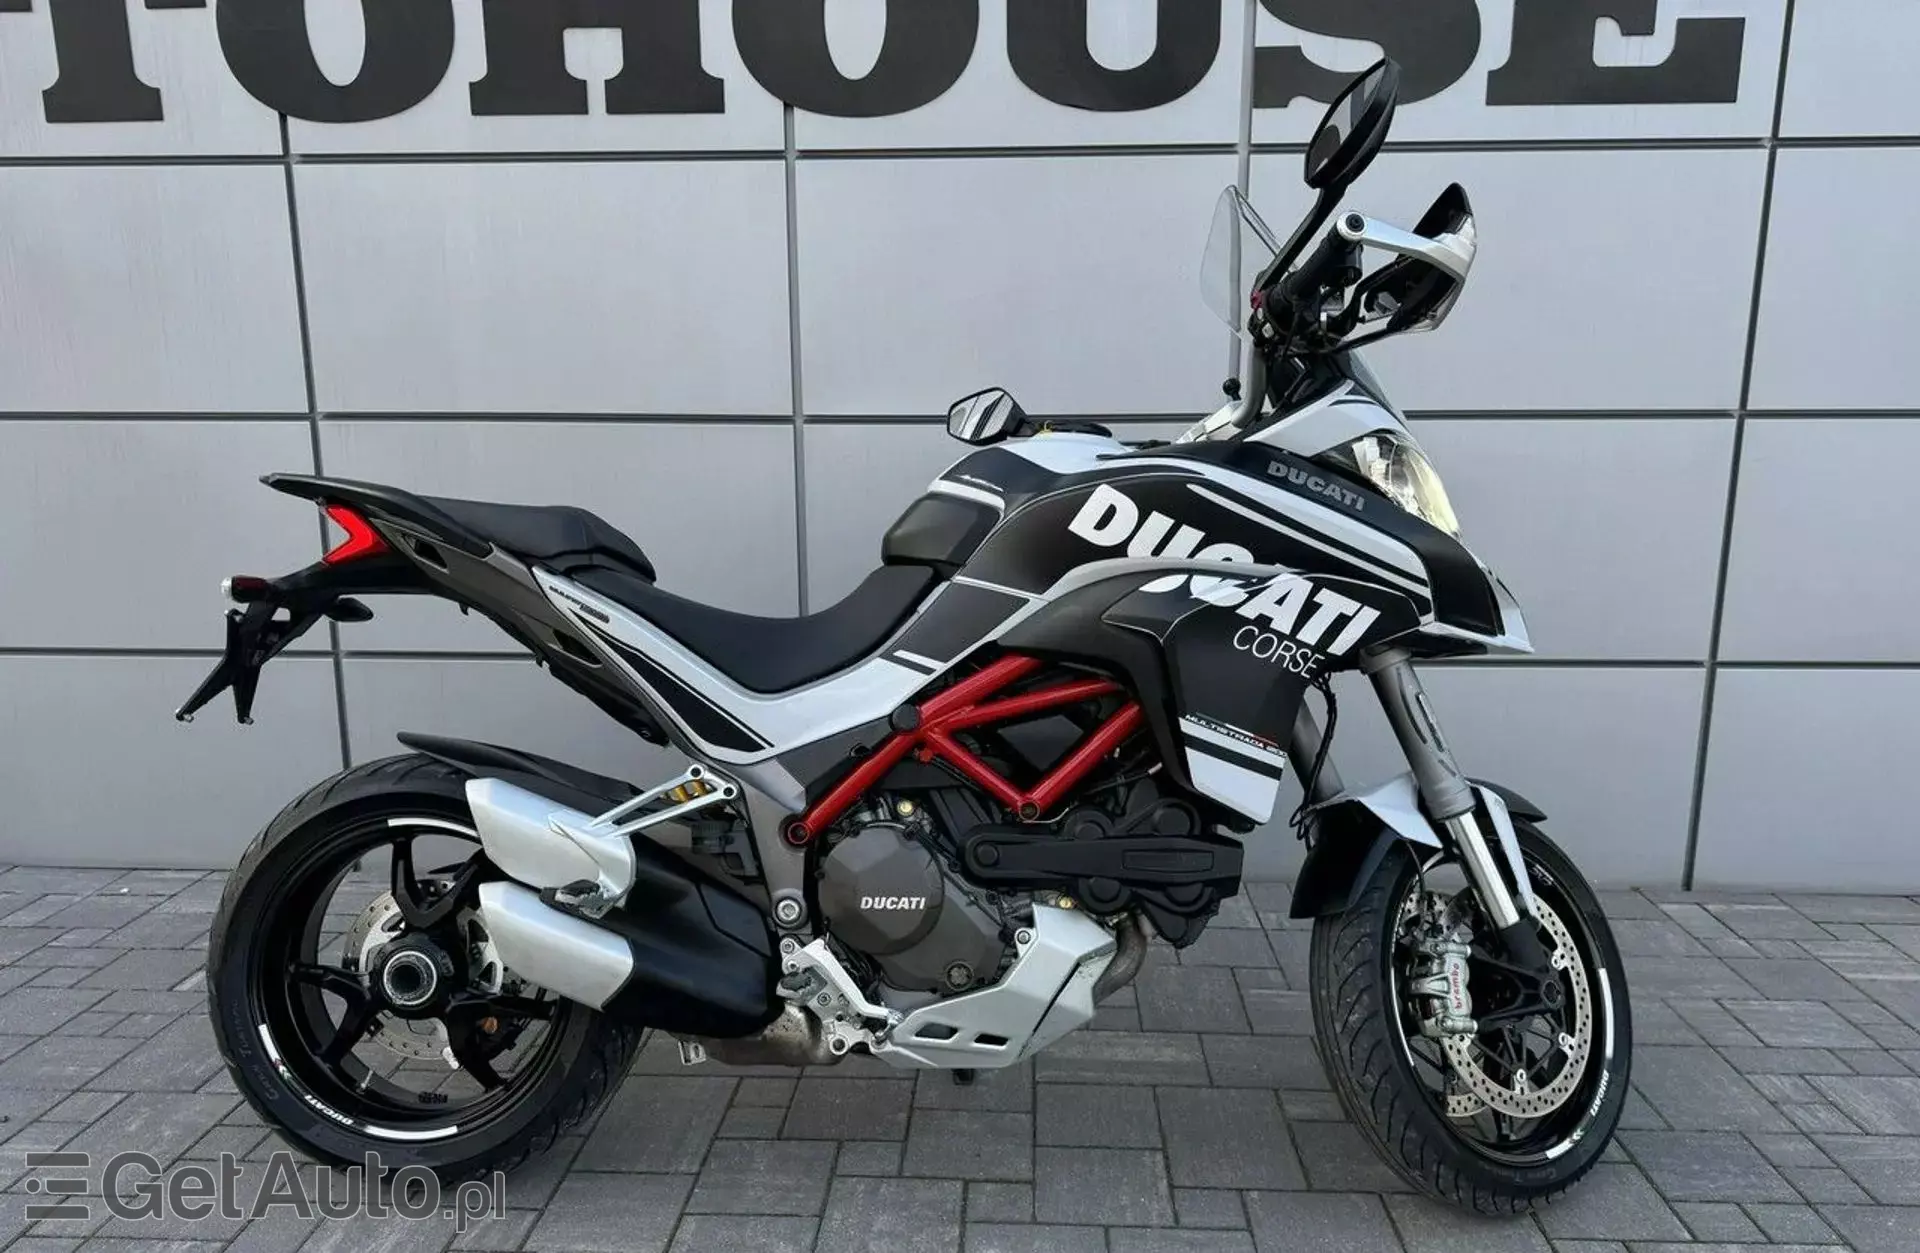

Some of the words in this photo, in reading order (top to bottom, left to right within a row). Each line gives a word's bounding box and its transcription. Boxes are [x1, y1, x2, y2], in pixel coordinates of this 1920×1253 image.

[1266, 460, 1365, 512] DUCATI
[1067, 483, 1381, 656] DUCATI
[1232, 625, 1325, 683] CORSE
[1185, 714, 1264, 749] MULTISTRADA
[860, 896, 926, 910] DUCATI
[1451, 963, 1463, 1010] brembo
[303, 1094, 354, 1125] DUCATI
[1590, 1068, 1610, 1117] DUCATI
